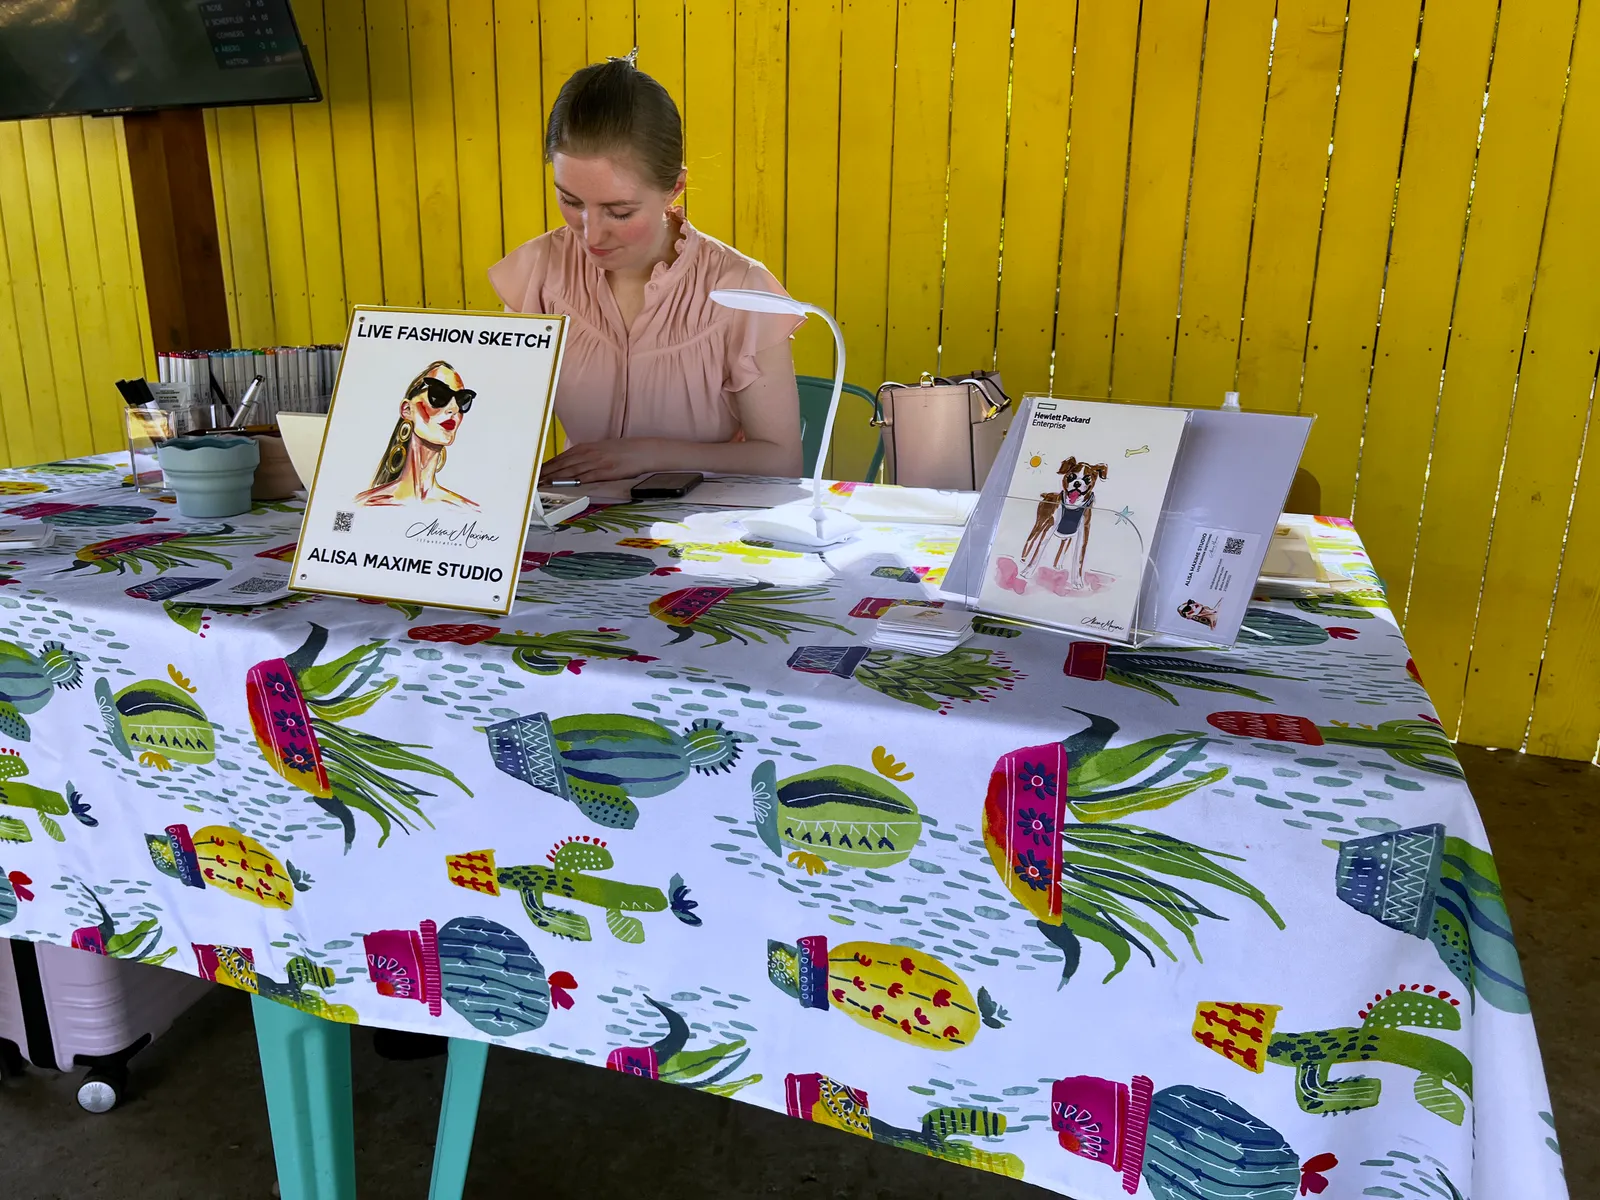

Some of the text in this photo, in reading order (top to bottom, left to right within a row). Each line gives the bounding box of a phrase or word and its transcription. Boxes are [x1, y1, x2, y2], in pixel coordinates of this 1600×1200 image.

[357, 323, 551, 349] LIVE FASHION SKETCH
[1032, 418, 1066, 430] Enterprise
[1034, 411, 1091, 425] Hewlett Packard
[308, 547, 504, 583] ALISA MAXIME STUDIO
[1184, 572, 1194, 587] ALISA
